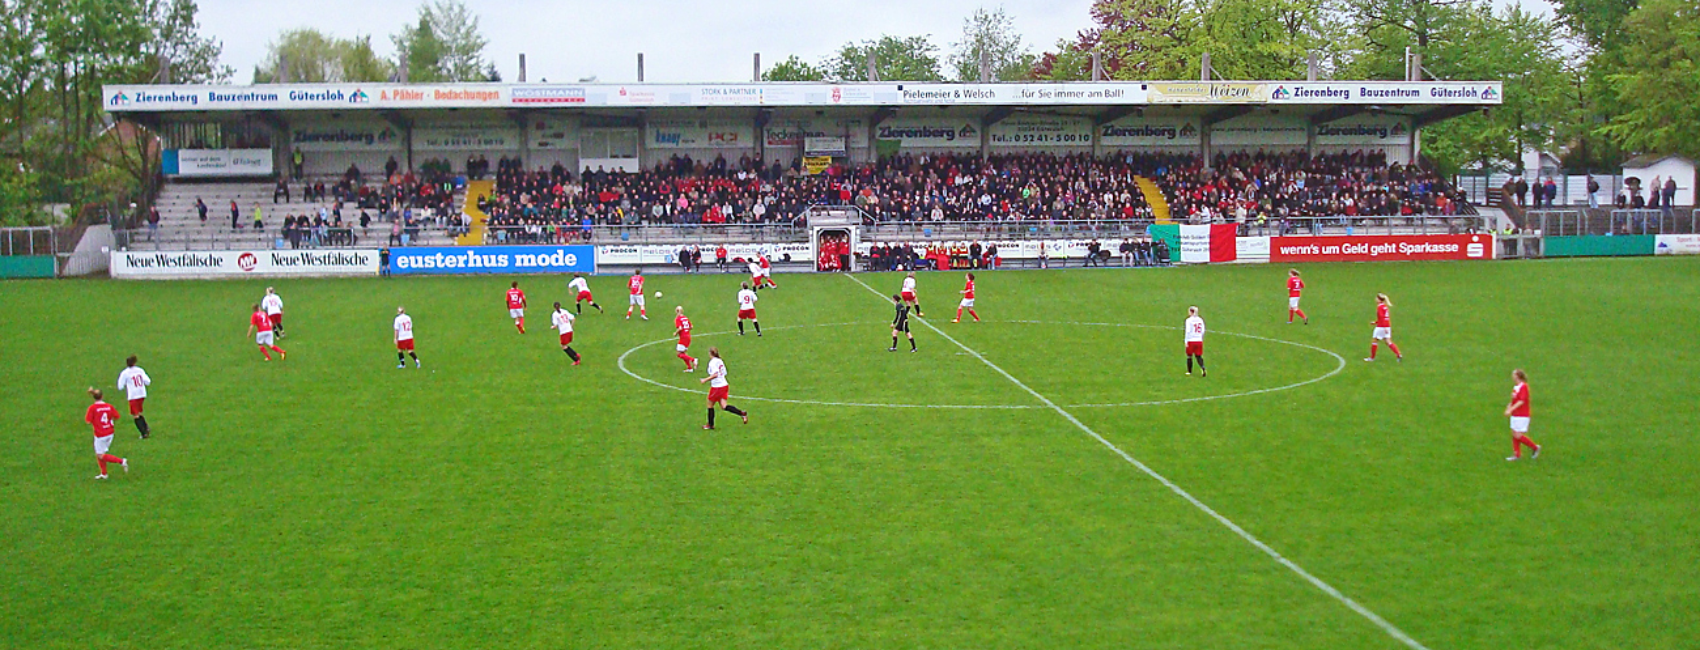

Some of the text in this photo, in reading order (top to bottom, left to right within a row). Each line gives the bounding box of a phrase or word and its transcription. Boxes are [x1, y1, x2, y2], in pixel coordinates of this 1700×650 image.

[135, 89, 344, 105] Zierenberg Bauzentrum Gütersloh
[380, 90, 391, 100] A.
[393, 89, 424, 100] Pähler
[434, 89, 499, 102] Bedachungen
[903, 89, 995, 99] Pielemeier & Welsch
[1037, 89, 1052, 99] Sie
[1054, 88, 1085, 99] immer
[1087, 89, 1103, 98] am
[1104, 88, 1124, 99] Ball!
[1294, 86, 1478, 99] Zierenberg Bauzentrum Gütersloh
[878, 125, 955, 141] Zierenberg
[1014, 134, 1021, 142] 0
[1023, 134, 1035, 142] 52
[1036, 134, 1048, 142] 41
[1056, 134, 1062, 142] 5
[1063, 134, 1076, 142] 00
[1078, 134, 1090, 142] 10
[1102, 124, 1176, 140] Zierenberg
[1317, 124, 1387, 139] Zierenberg
[1280, 242, 1459, 256] wenn's um Geld geht Sparkasse
[126, 252, 223, 268] Neue Westfälische
[271, 251, 368, 267] Neue Westfälische
[397, 250, 577, 268] eusterhus mode
[743, 295, 750, 304] 9
[1193, 323, 1202, 333] 16
[131, 374, 143, 387] 10
[101, 412, 108, 424] 4
